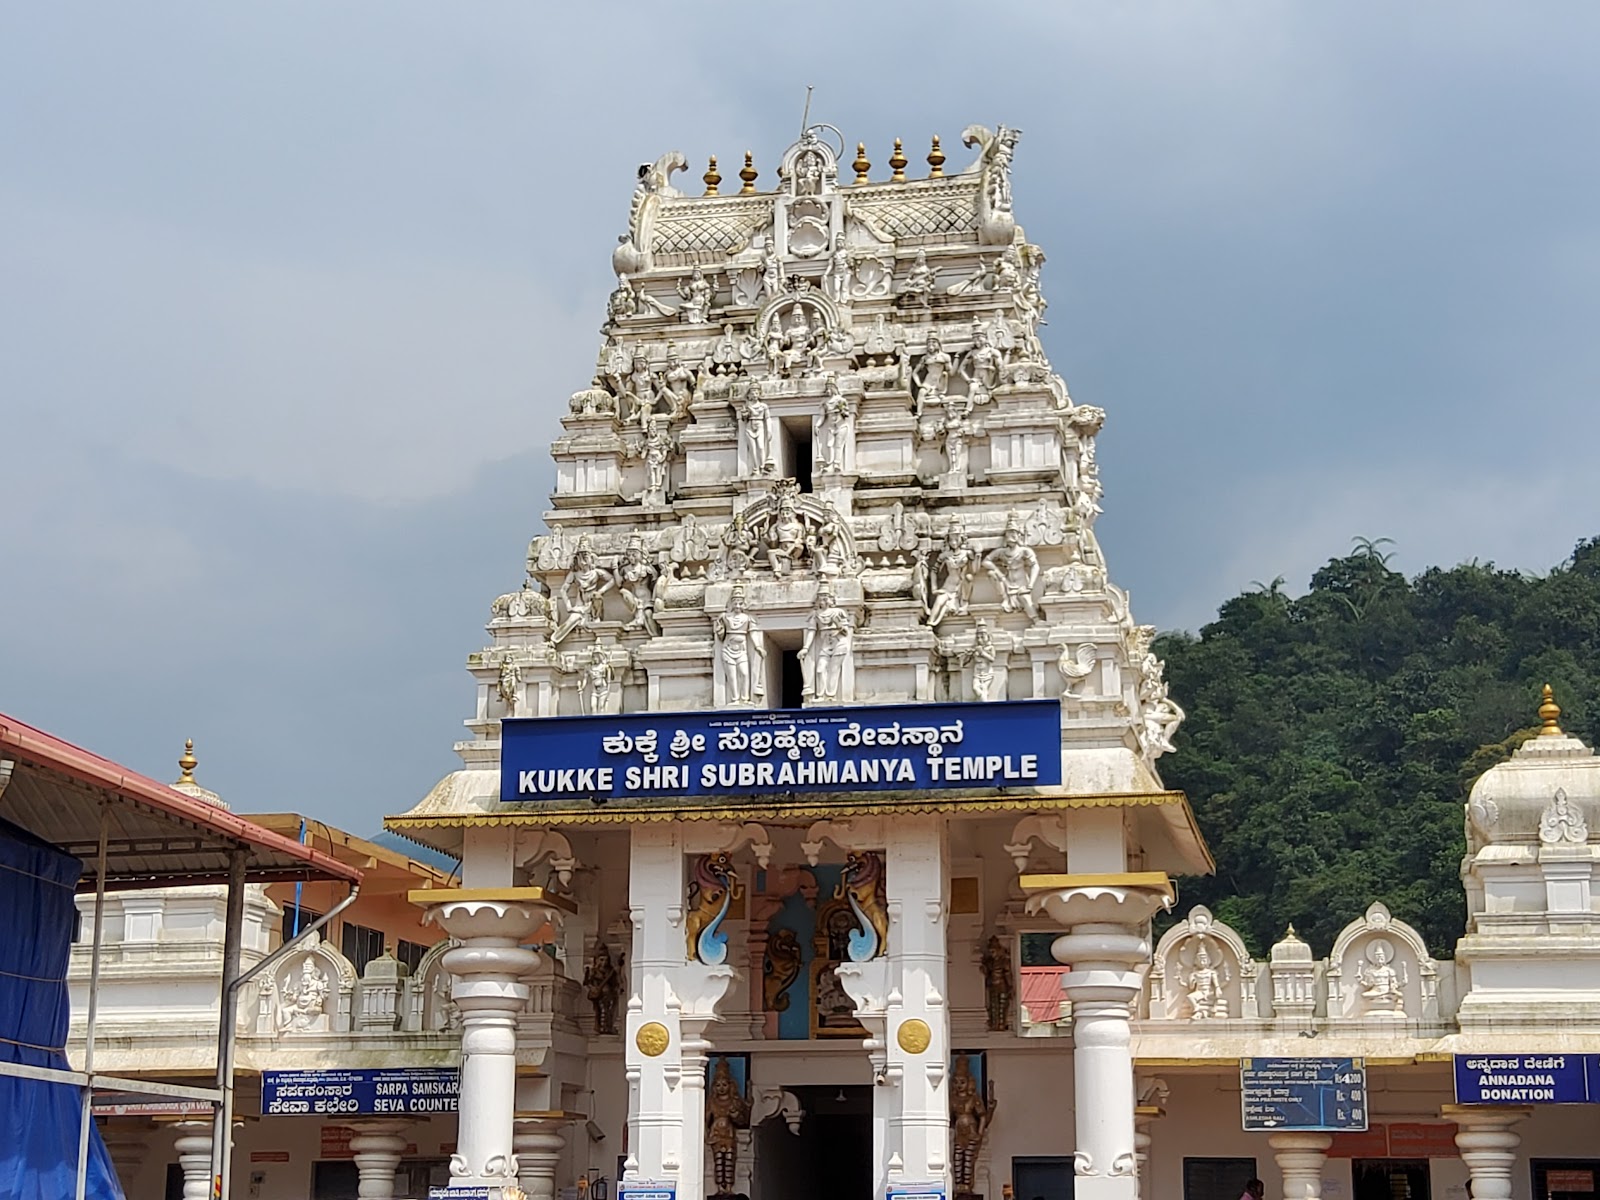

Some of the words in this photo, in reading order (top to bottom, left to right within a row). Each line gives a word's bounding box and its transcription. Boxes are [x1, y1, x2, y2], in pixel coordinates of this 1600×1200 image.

[602, 729, 659, 763] ಕುಕ್ಕೆ
[669, 729, 706, 758] ಶ್ರೀ
[718, 725, 826, 760] ಸುಬ್ರಹ್ಮಣ್ಯ
[838, 719, 963, 757] ದೇವಸ್ಥಾನ
[519, 767, 614, 794] KUKKE
[625, 764, 689, 790] SHRI
[700, 757, 916, 788] SUBRAHMANYA
[926, 754, 1038, 782] TEMPLE
[1466, 1057, 1519, 1074] ಅನ್ನದಾನ
[1523, 1056, 1565, 1069] ದೇಣಿಗೆ
[1479, 1075, 1555, 1086] ANNADANA
[375, 1082, 409, 1096] SARPA
[1350, 1089, 1361, 1102] 400
[1480, 1089, 1554, 1100] DONATION
[269, 1098, 310, 1113] ಸೇವಾ
[374, 1098, 405, 1112] SEVA
[1351, 1108, 1362, 1121] 400
